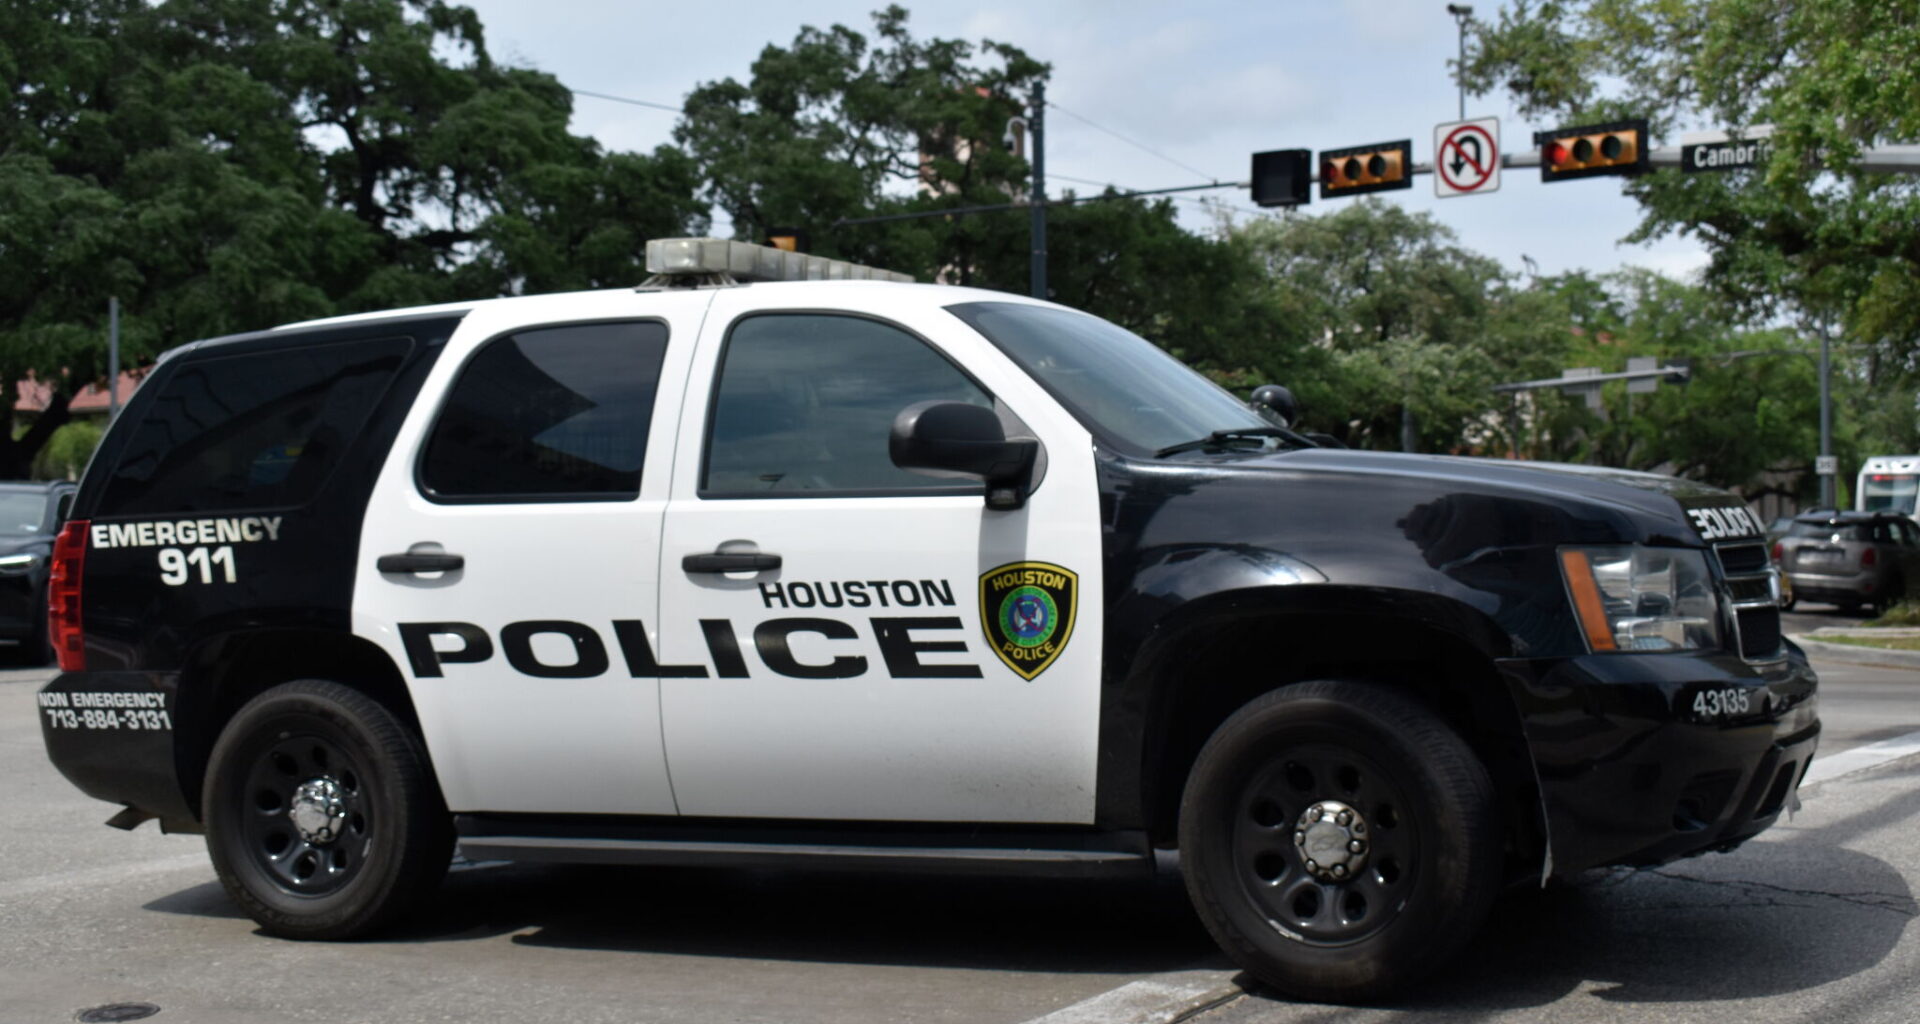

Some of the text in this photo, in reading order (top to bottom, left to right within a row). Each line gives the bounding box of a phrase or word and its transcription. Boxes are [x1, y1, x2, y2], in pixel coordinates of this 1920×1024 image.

[91, 517, 282, 549] EMERGENCY
[158, 546, 237, 586] 911
[760, 579, 956, 608] HOUSTON
[992, 570, 1066, 591] HOUSTON
[397, 616, 984, 679] POLICE
[1002, 641, 1055, 660] POLICE
[38, 692, 166, 708] NON EMERGENCY
[1693, 689, 1750, 716] 43135
[47, 709, 172, 730] 713-884-3131
